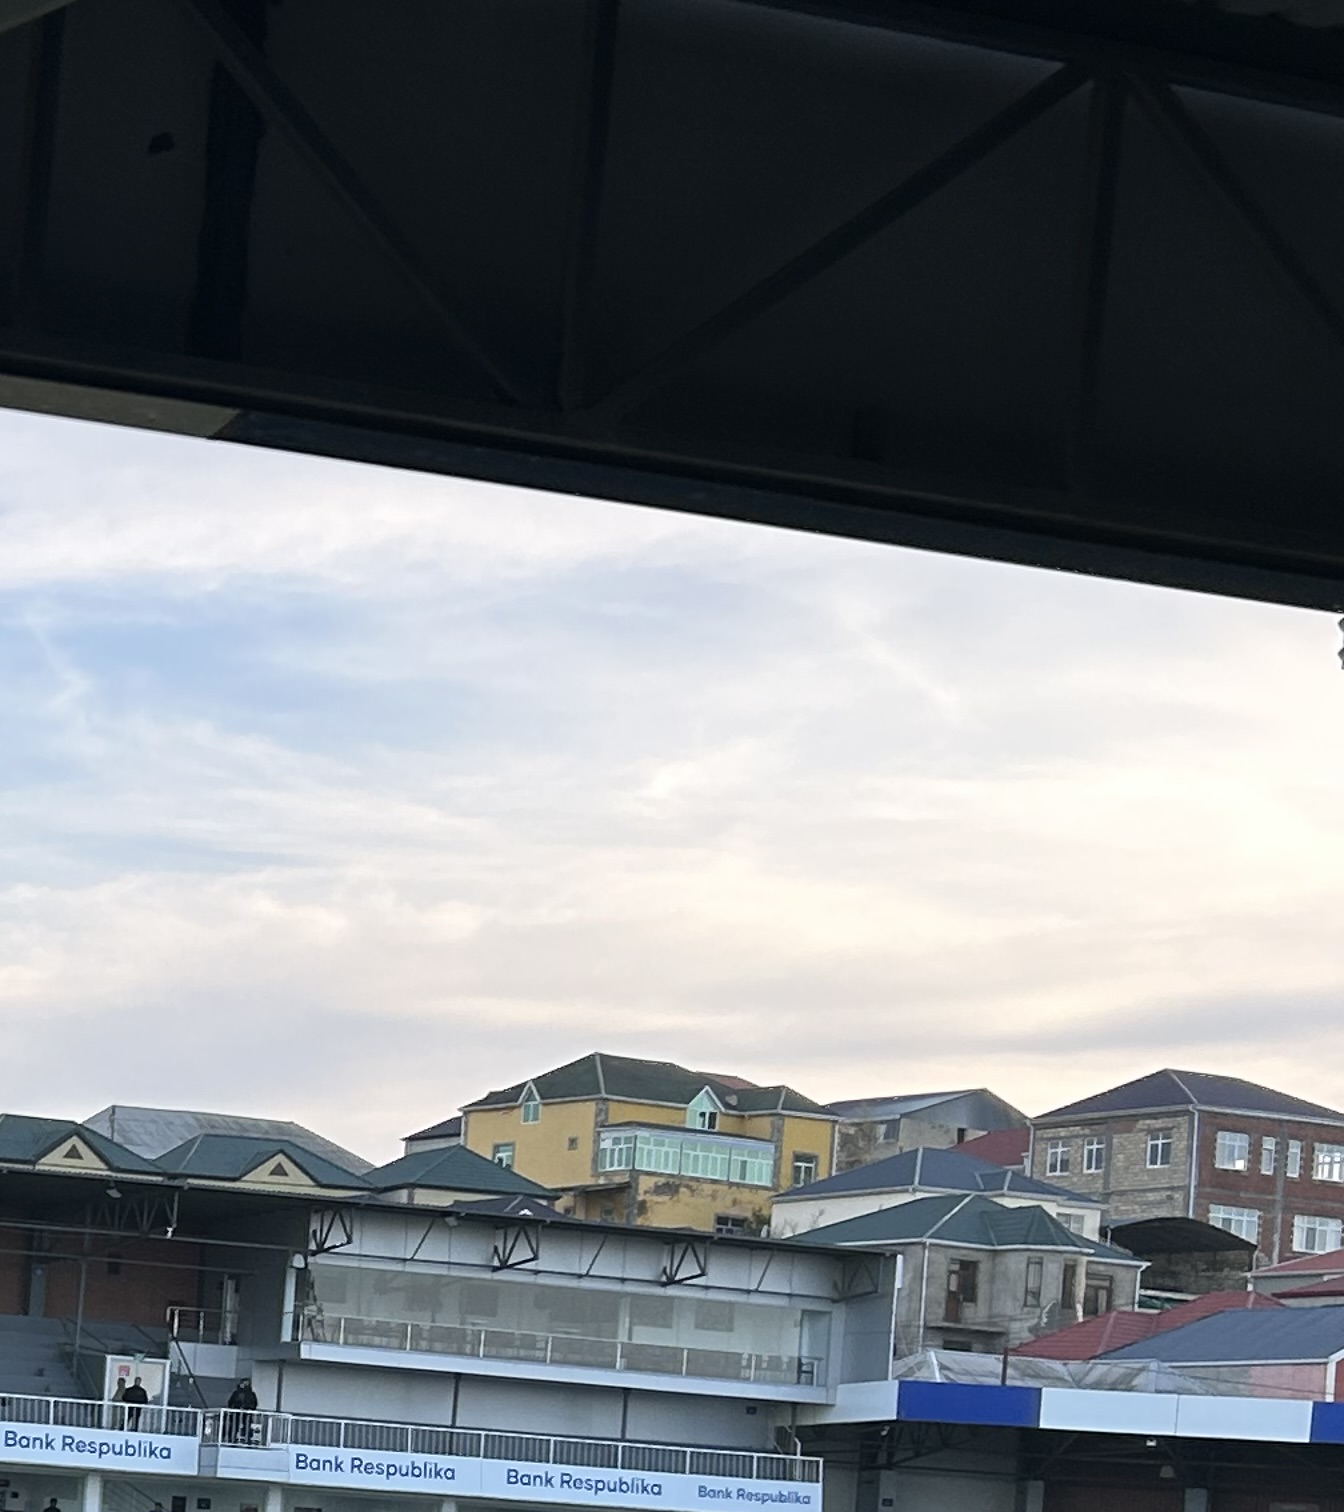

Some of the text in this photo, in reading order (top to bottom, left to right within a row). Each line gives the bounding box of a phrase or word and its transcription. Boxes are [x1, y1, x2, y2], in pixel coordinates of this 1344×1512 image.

[4, 1430, 172, 1460] Bank Respublika
[295, 1452, 456, 1481] Bank Respublika
[506, 1468, 662, 1496] Bank Respublika
[698, 1485, 811, 1505] Bank Respublika
